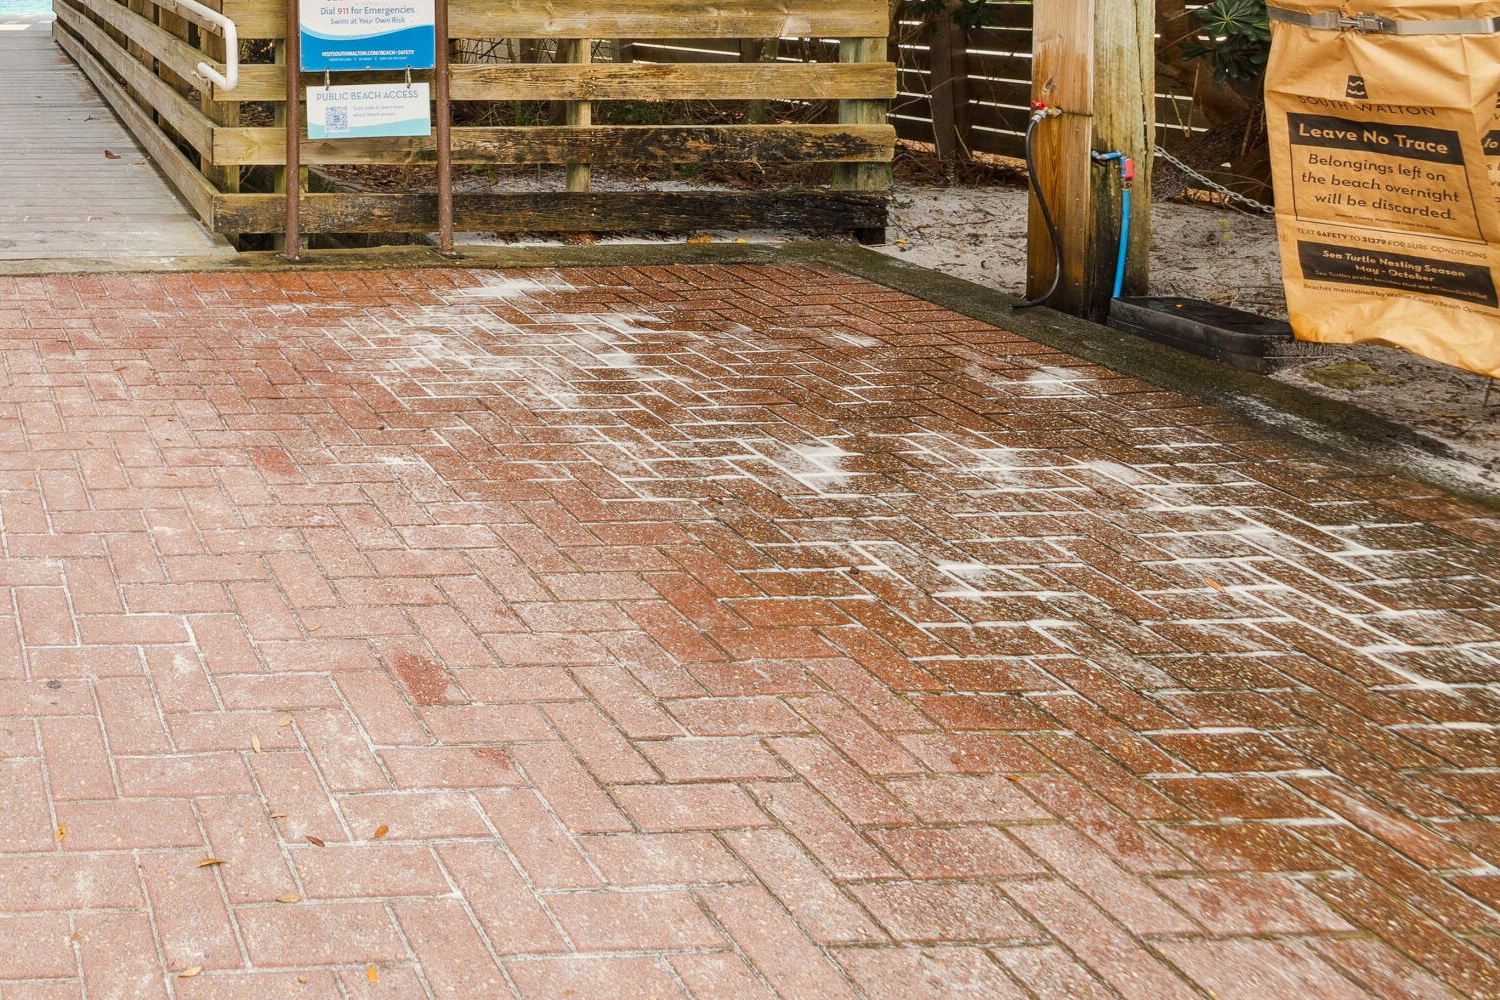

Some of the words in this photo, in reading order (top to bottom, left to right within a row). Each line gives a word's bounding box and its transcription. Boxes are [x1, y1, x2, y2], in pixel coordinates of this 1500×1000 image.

[321, 7, 335, 15] Dial
[365, 6, 415, 16] Emergencies
[317, 92, 348, 101] PUBLIC
[351, 91, 381, 100] BEACH
[383, 90, 418, 99] ACCESS
[1298, 95, 1349, 111] SOUTH
[1355, 104, 1437, 117] WALTON
[1299, 123, 1358, 141] Leave
[1363, 130, 1389, 145] No
[1394, 134, 1449, 154] Trace
[1308, 153, 1394, 175] Belongings
[1399, 164, 1422, 179] left
[1427, 171, 1446, 182] on
[1301, 172, 1326, 185] the
[1331, 175, 1381, 190] beach
[1385, 184, 1460, 202] overnight
[1315, 193, 1341, 205] will
[1347, 195, 1366, 208] be
[1372, 198, 1457, 221] discarded.
[1316, 231, 1348, 239] SAFETY
[1362, 237, 1386, 245] 31279
[1387, 240, 1405, 248] FOR
[1407, 242, 1429, 250] SURF
[1431, 245, 1487, 259] CONDITIONS
[1322, 250, 1343, 259] Sea
[1345, 253, 1376, 264] Turtle
[1379, 258, 1421, 272] Nesting
[1424, 264, 1465, 277] Season
[1355, 265, 1379, 275] May
[1388, 269, 1435, 282] October
[1303, 284, 1332, 292] Beaches
[1333, 288, 1374, 296] maintained
[1386, 292, 1412, 300] Walton
[1413, 296, 1438, 306] County
[1439, 301, 1461, 310] Beach
